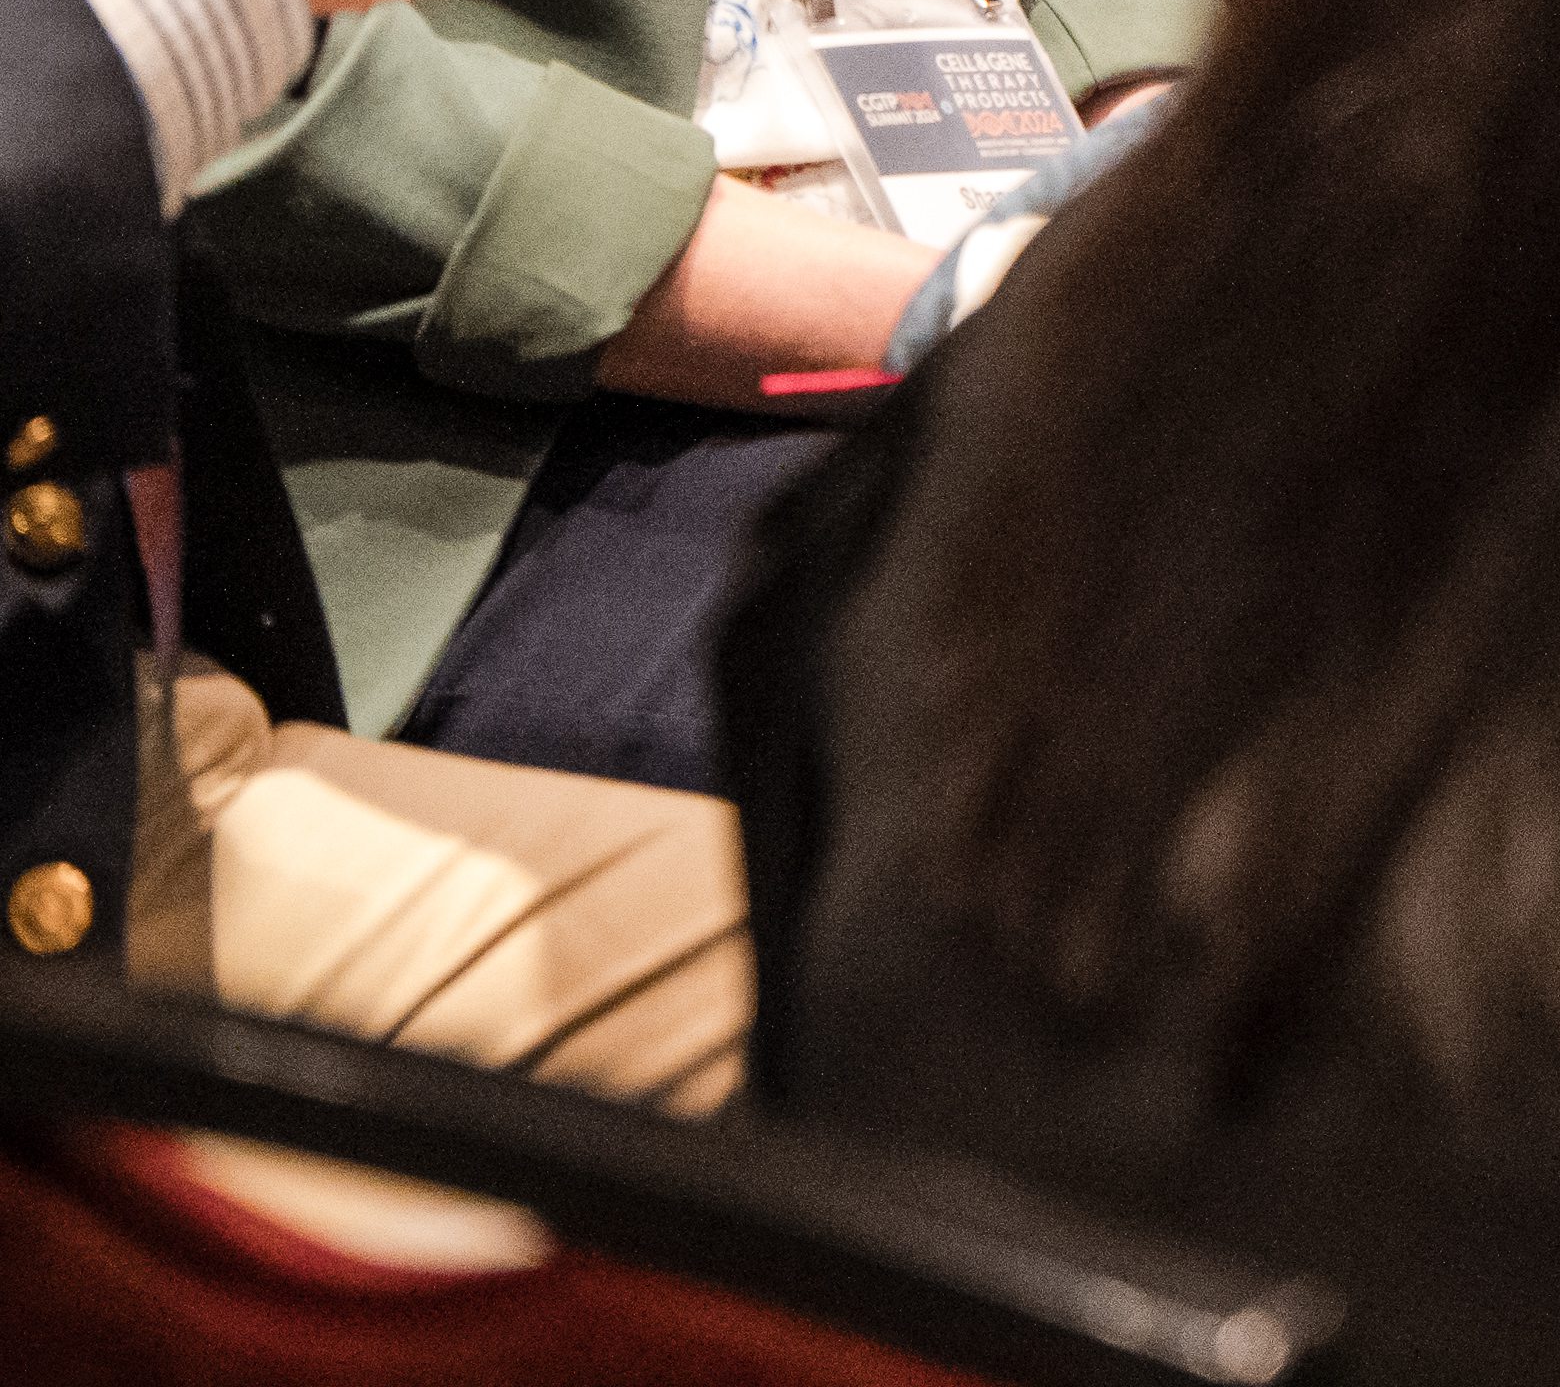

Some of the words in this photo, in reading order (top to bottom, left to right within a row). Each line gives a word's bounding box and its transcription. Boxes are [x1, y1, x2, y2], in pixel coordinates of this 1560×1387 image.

[944, 73, 1041, 91] THERAPY
[953, 90, 1051, 108] PRODUCTS
[959, 186, 1003, 211] Sha
